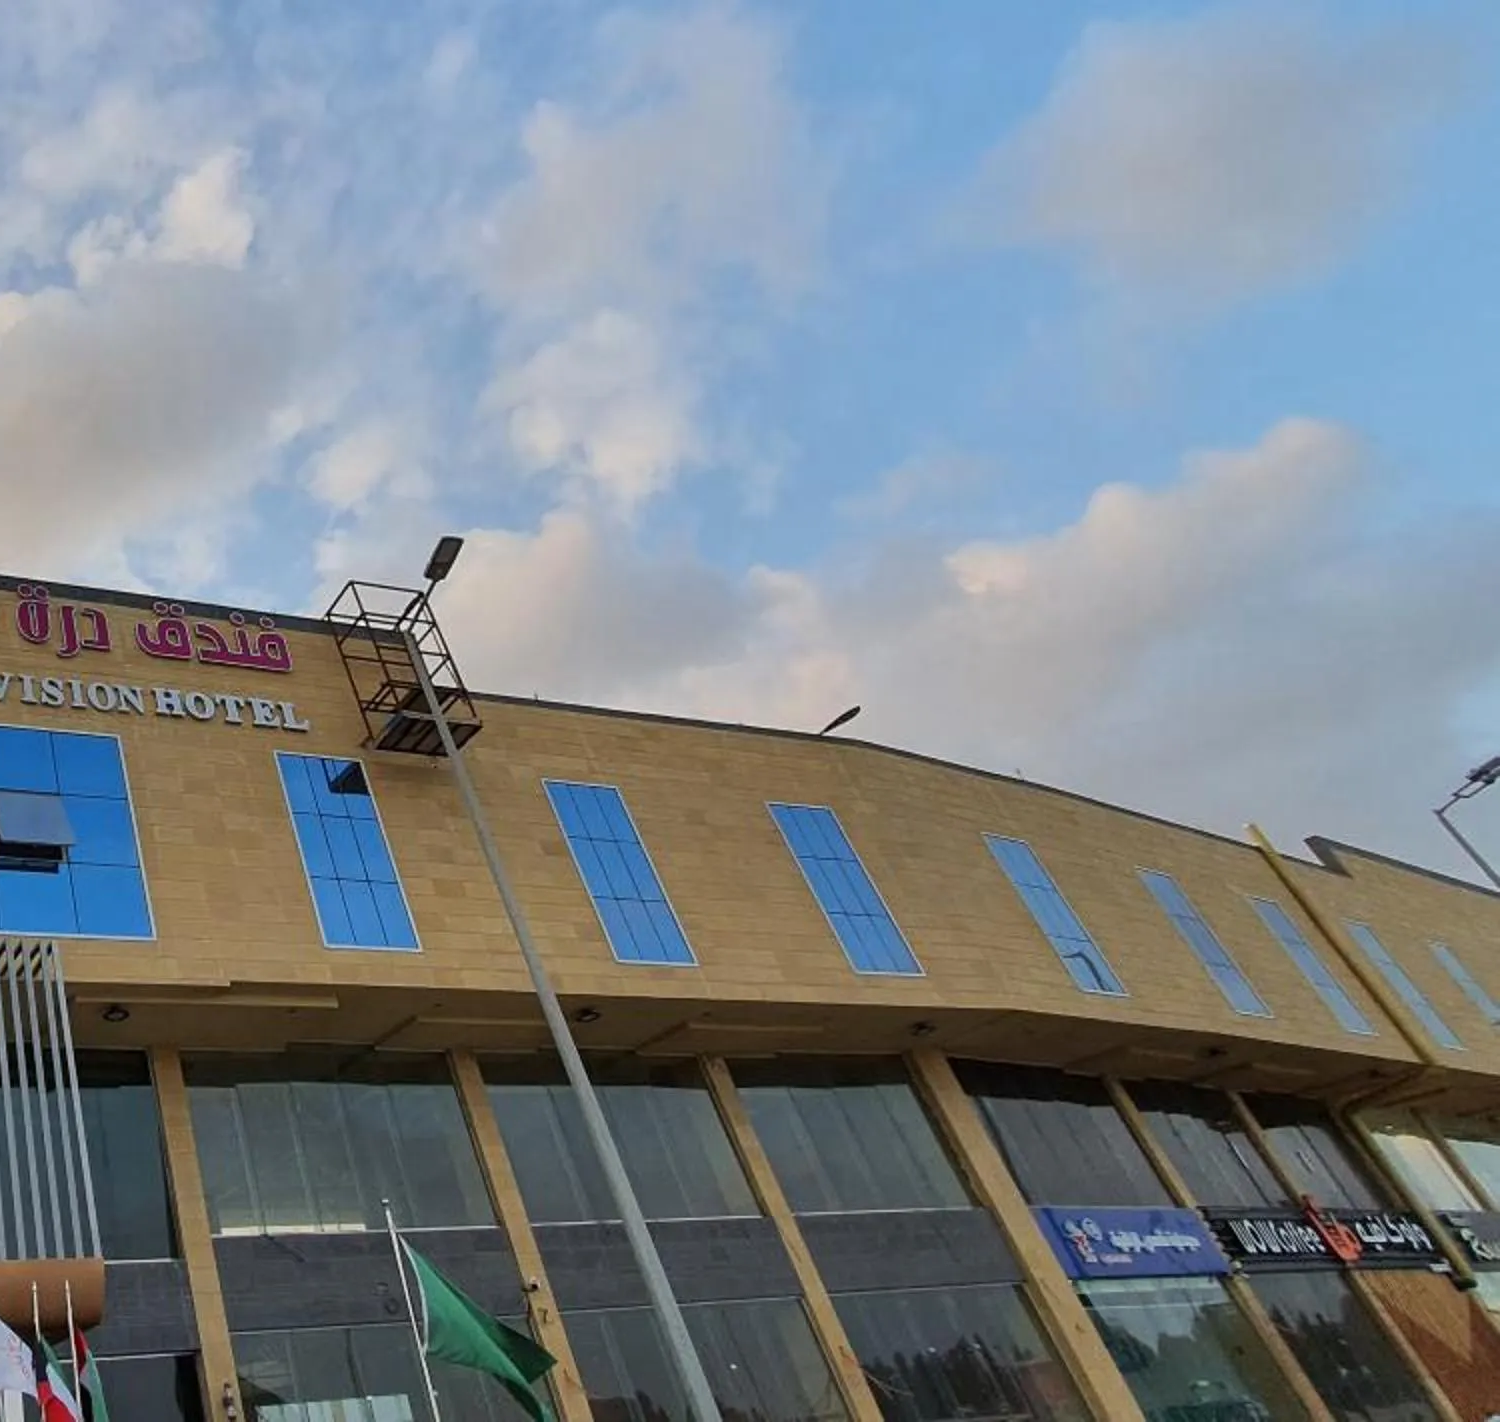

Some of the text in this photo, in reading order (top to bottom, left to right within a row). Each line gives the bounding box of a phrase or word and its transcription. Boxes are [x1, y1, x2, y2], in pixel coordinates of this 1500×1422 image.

[15, 583, 112, 658] درة
[135, 601, 293, 672] فندق
[151, 687, 311, 733] HOTEL
